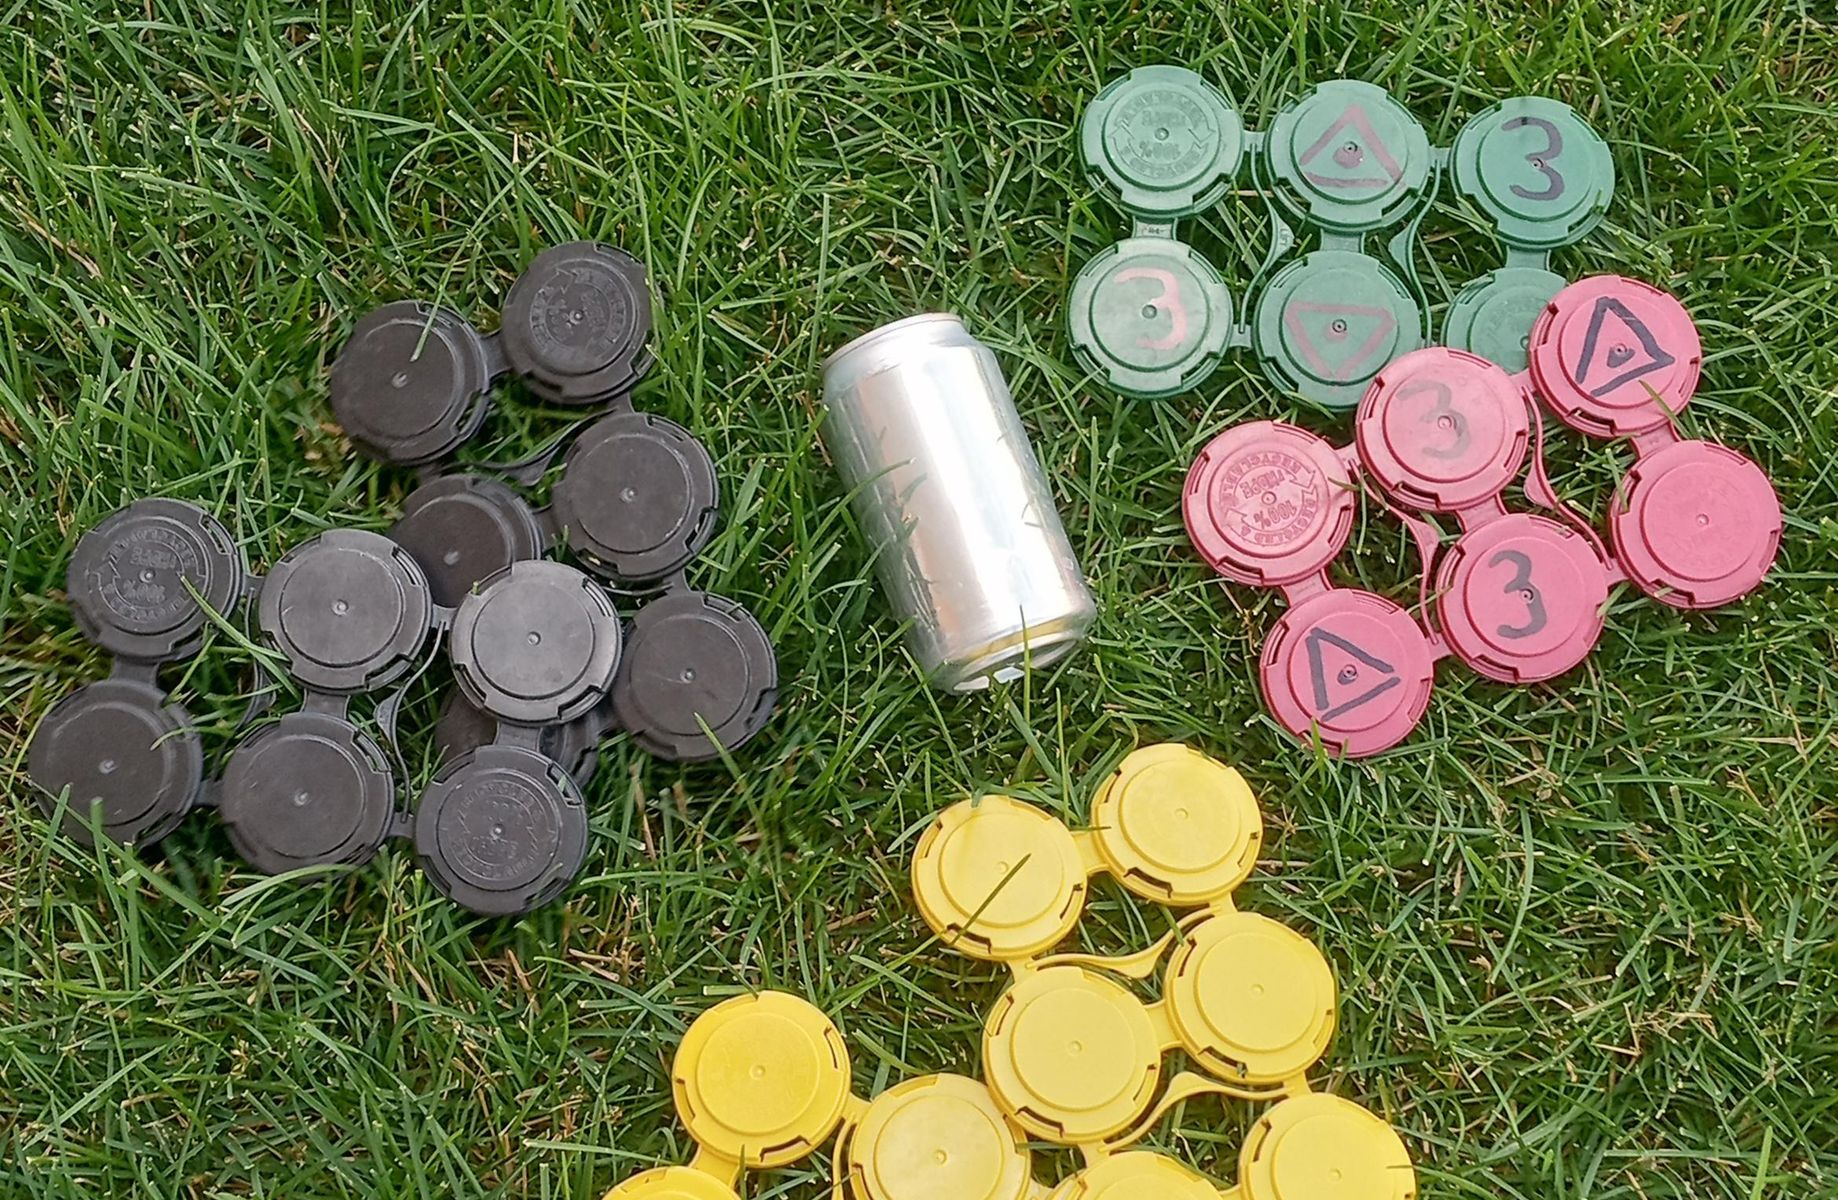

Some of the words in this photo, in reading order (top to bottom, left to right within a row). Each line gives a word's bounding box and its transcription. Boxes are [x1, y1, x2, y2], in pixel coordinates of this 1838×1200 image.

[1501, 117, 1565, 201] 3
[1112, 267, 1187, 350] 3
[1397, 379, 1470, 460] 3
[1488, 549, 1547, 639] 3
